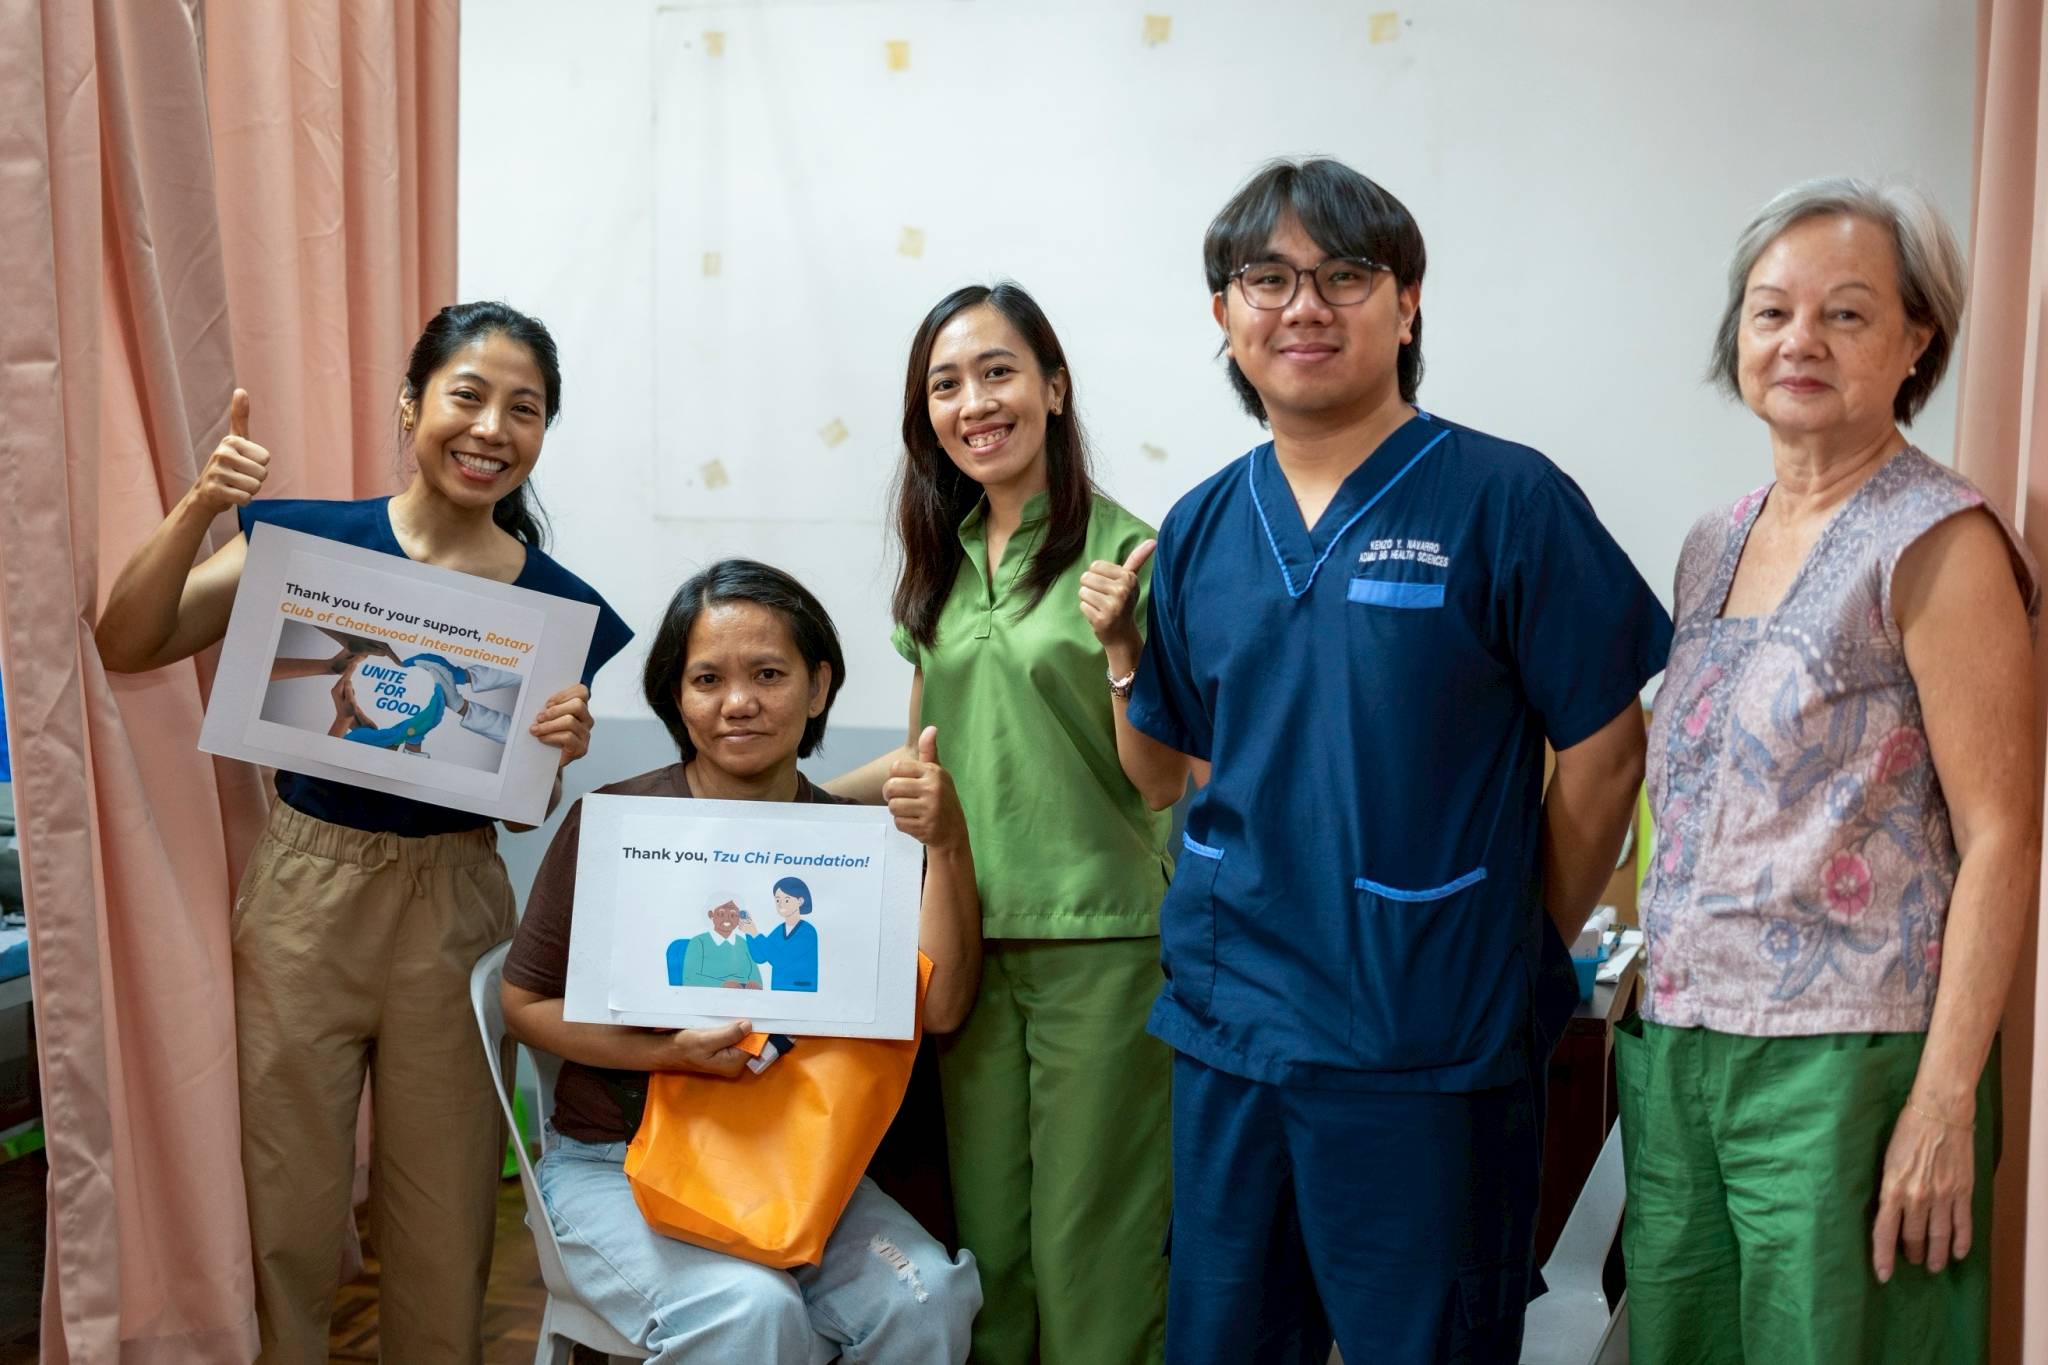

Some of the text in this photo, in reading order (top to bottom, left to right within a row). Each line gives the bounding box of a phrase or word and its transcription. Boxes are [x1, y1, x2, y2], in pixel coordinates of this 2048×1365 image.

[1370, 539, 1440, 554] KENZO Y. NAVARRO
[1390, 549, 1415, 561] HEALTH
[1417, 551, 1449, 568] SCIENCES
[286, 582, 535, 654] Thank you for your support, Rotary
[280, 602, 520, 668] Club of Chatswood International!
[361, 664, 408, 684] UNITE
[374, 682, 406, 699] FOR
[376, 697, 421, 716] GOOD
[622, 847, 870, 868] Thank you, Tzu Chi Foundation!
